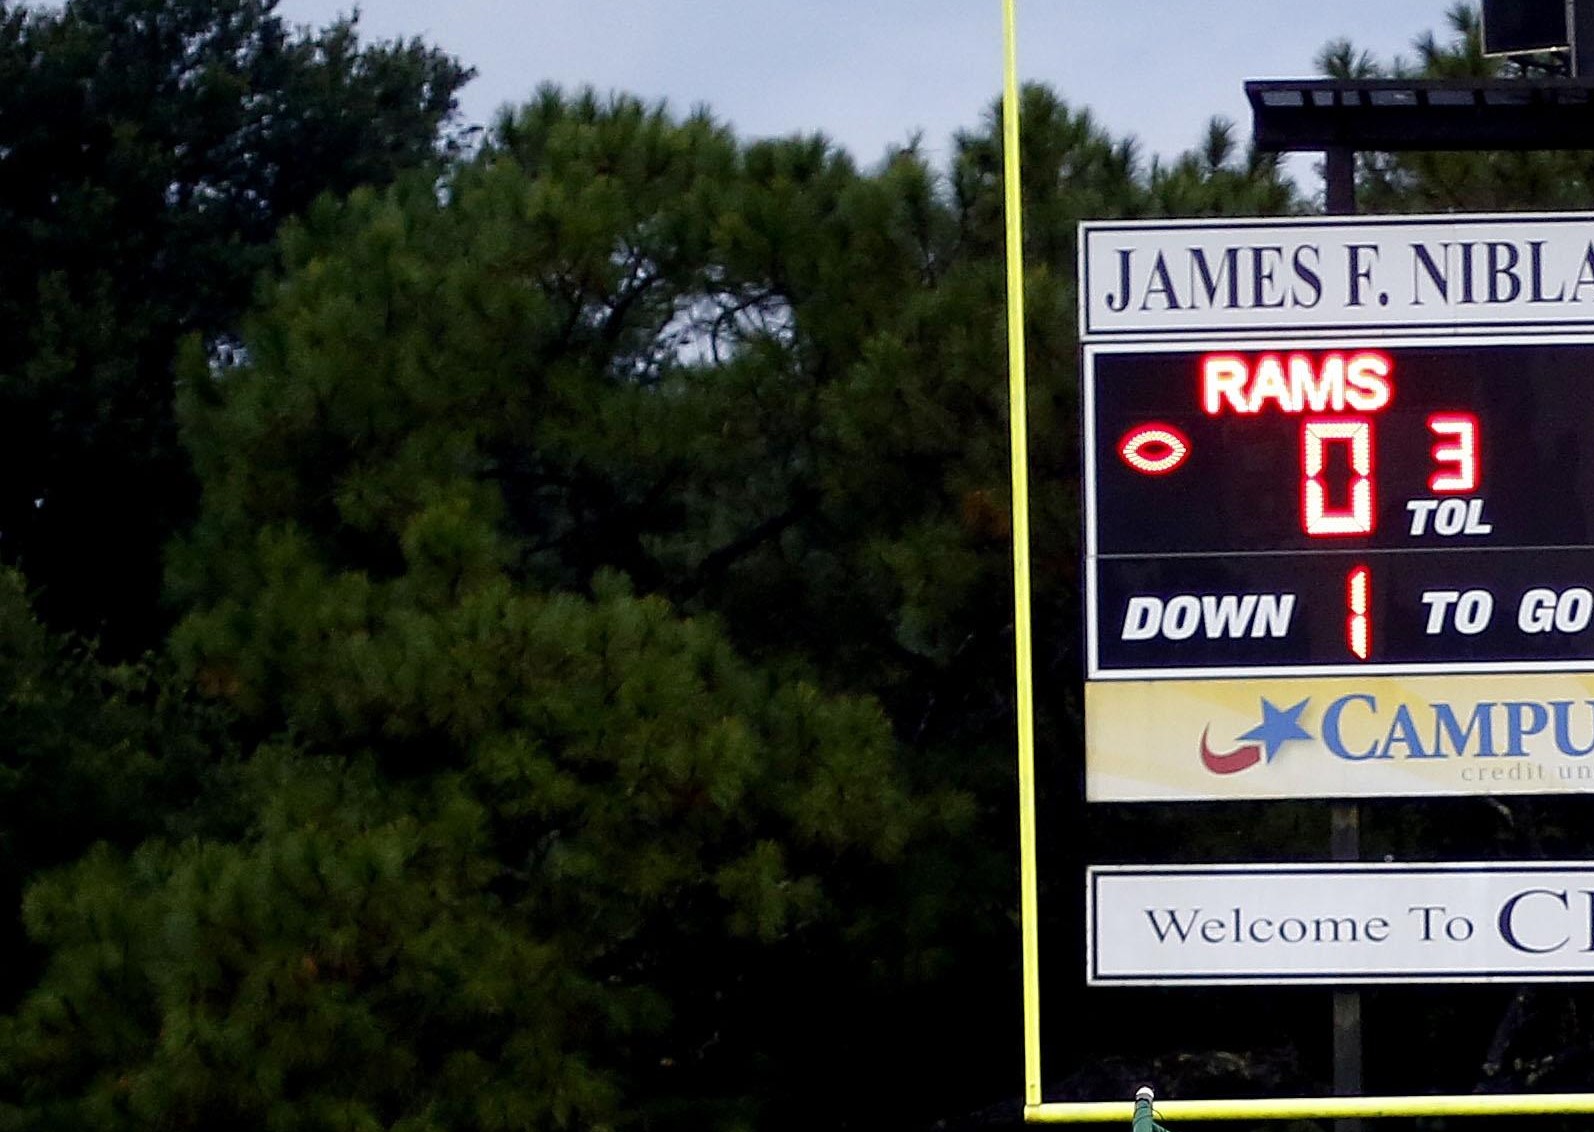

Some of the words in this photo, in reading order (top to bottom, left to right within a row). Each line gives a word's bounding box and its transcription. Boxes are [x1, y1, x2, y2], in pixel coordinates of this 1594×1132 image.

[1106, 243, 1323, 313] JAMES
[1346, 243, 1390, 308] F.
[1203, 357, 1392, 415] RAMS
[1303, 420, 1373, 534] 0
[1430, 417, 1475, 491] 3
[1405, 498, 1493, 536] TOL
[1120, 592, 1296, 641] DOWN
[1348, 566, 1370, 660] 1
[1421, 589, 1495, 635] TO
[1516, 587, 1594, 634] GO
[1460, 762, 1547, 783] credit
[1143, 906, 1391, 945] Welcome
[1407, 905, 1475, 943] To
